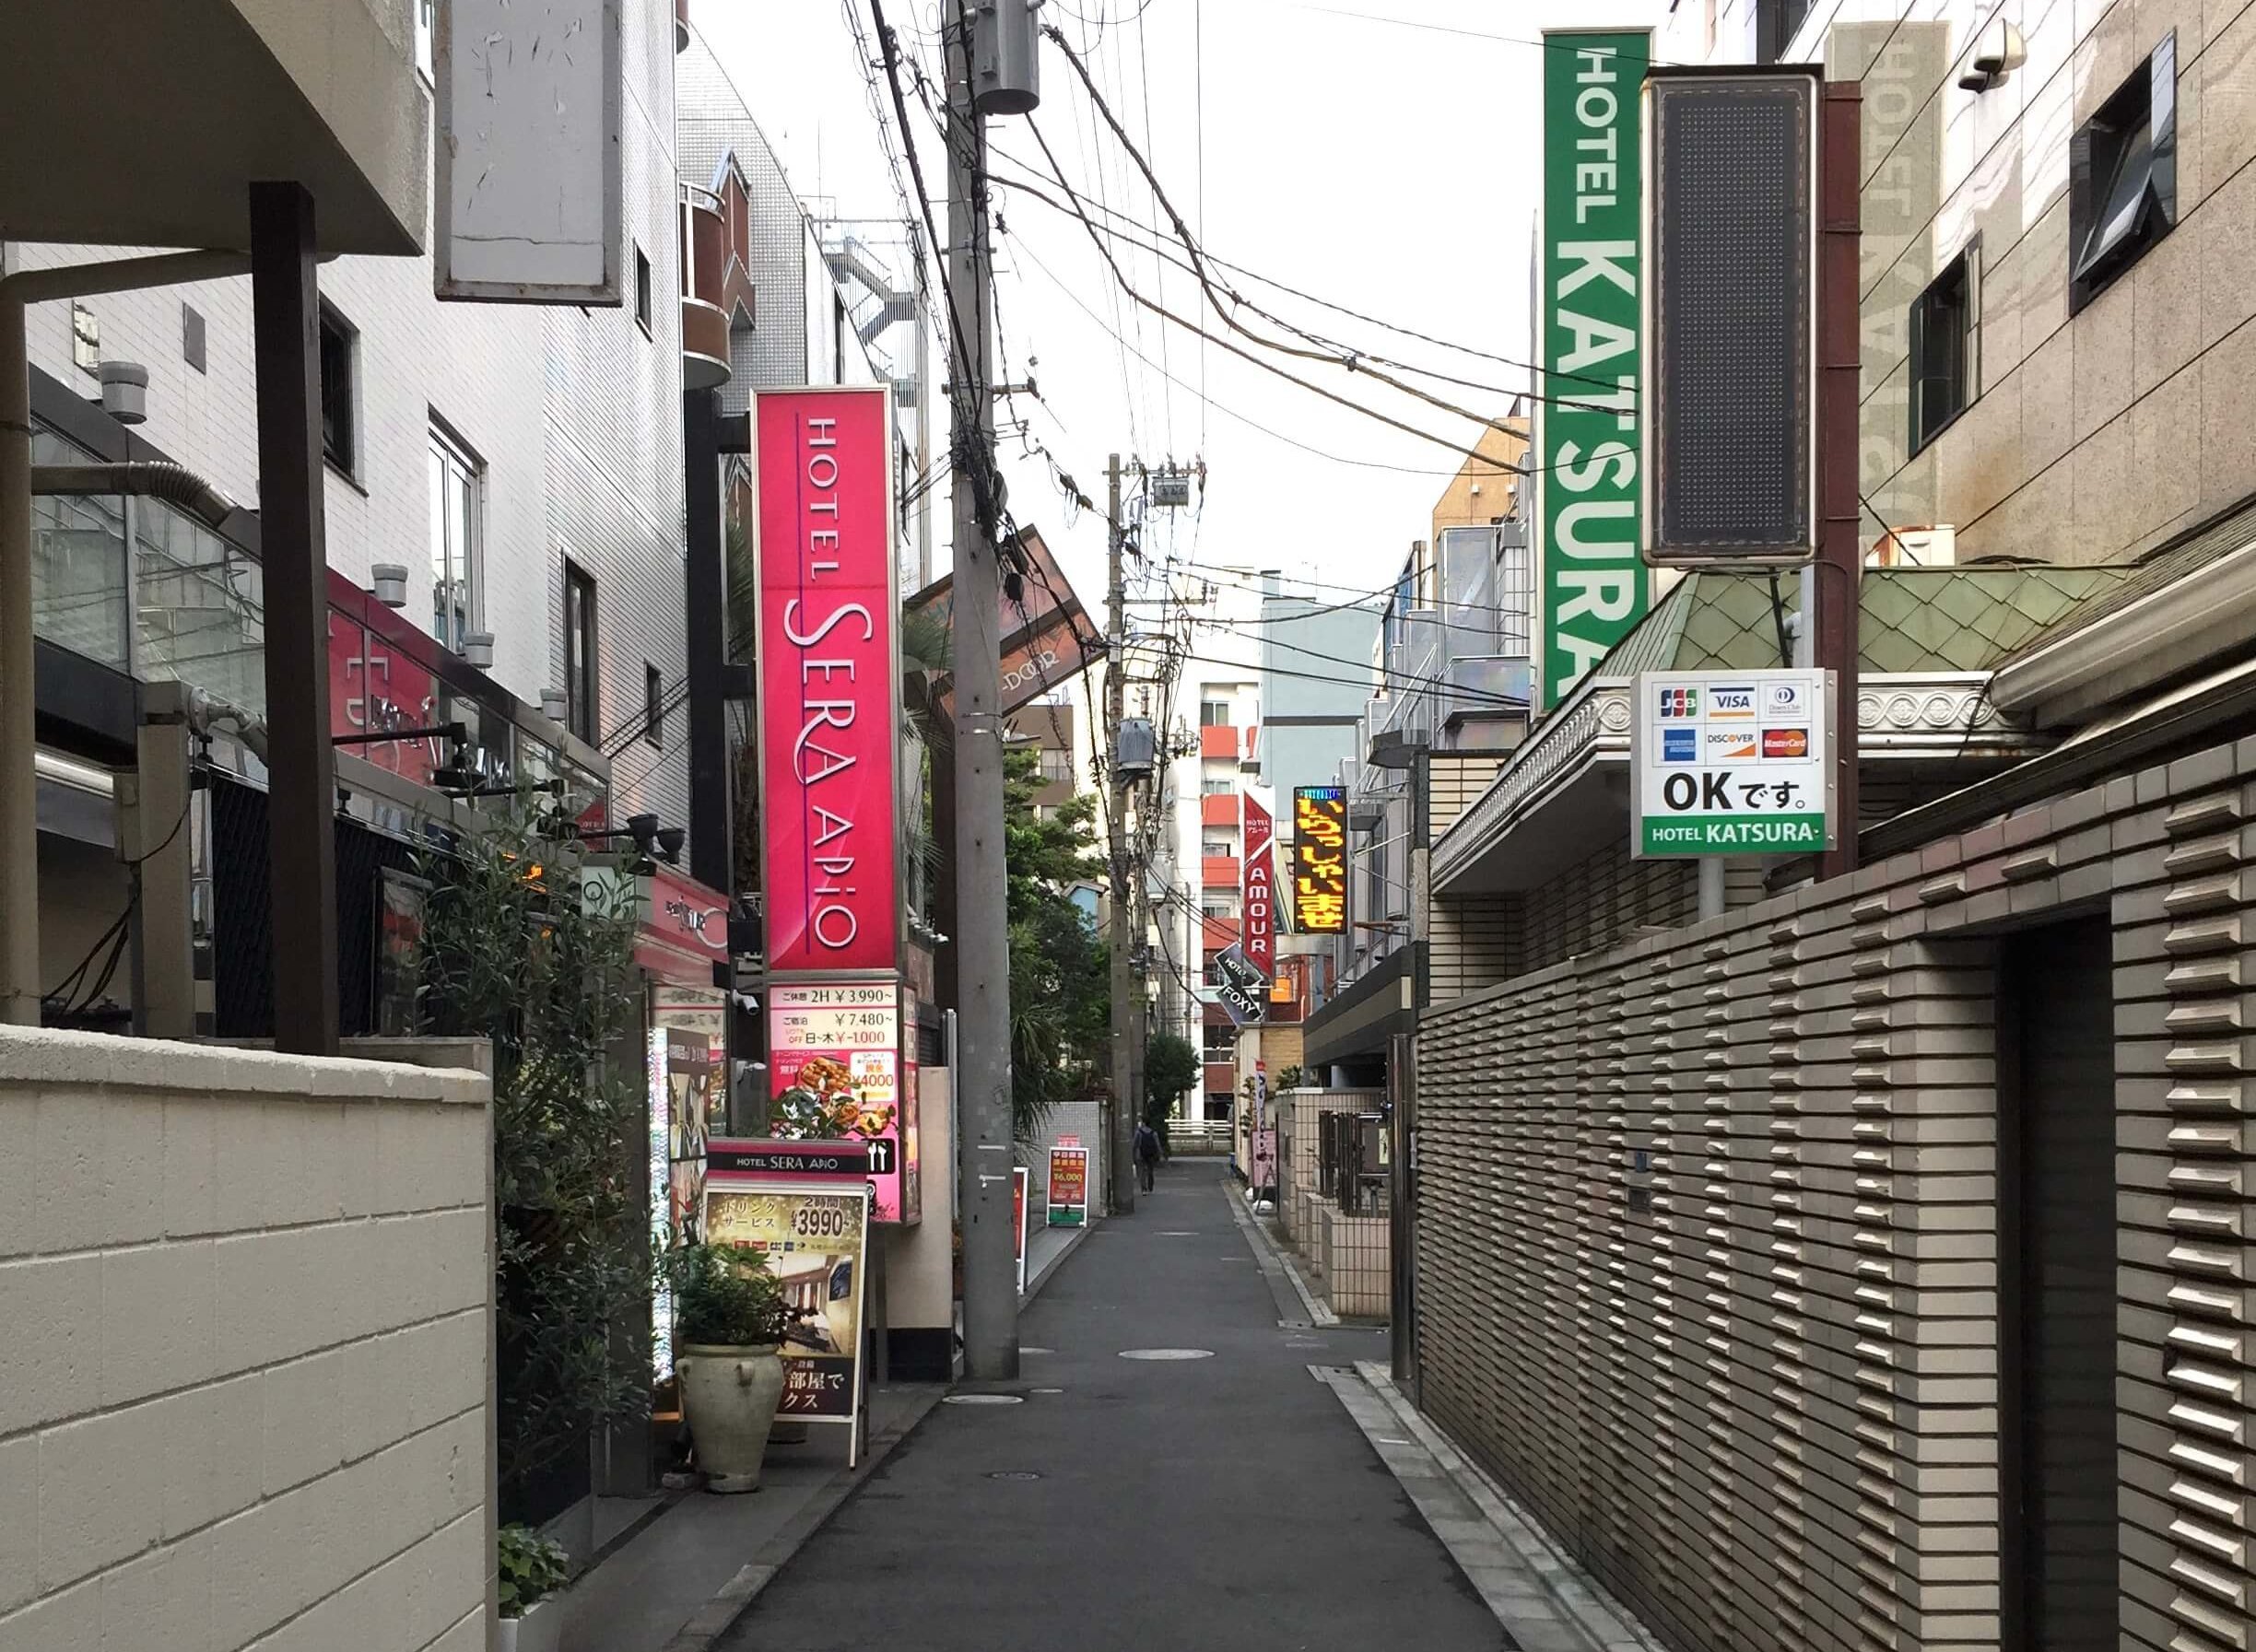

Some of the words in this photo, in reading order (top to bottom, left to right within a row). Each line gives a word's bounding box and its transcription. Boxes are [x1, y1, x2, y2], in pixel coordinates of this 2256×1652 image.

[1576, 48, 1617, 223] HOTEL
[1555, 240, 1637, 697] KATSURA
[808, 418, 840, 580] HOTEL
[783, 599, 874, 785] SERA
[1717, 696, 1751, 708] VISA
[1708, 733, 1754, 744] DISCOVER
[1764, 738, 1806, 749] MasterCard
[1652, 827, 1703, 842] HOTEL
[1707, 822, 1814, 844] KATSURA
[1249, 867, 1268, 953] AMOUR
[811, 990, 829, 1003] 2H
[1223, 986, 1255, 1013] FOXY
[736, 1157, 766, 1167] HOTEL
[770, 1155, 804, 1169] SERA
[724, 1201, 776, 1213] ドリンク
[723, 1217, 775, 1228] サービス
[782, 1371, 845, 1390] 部屋で
